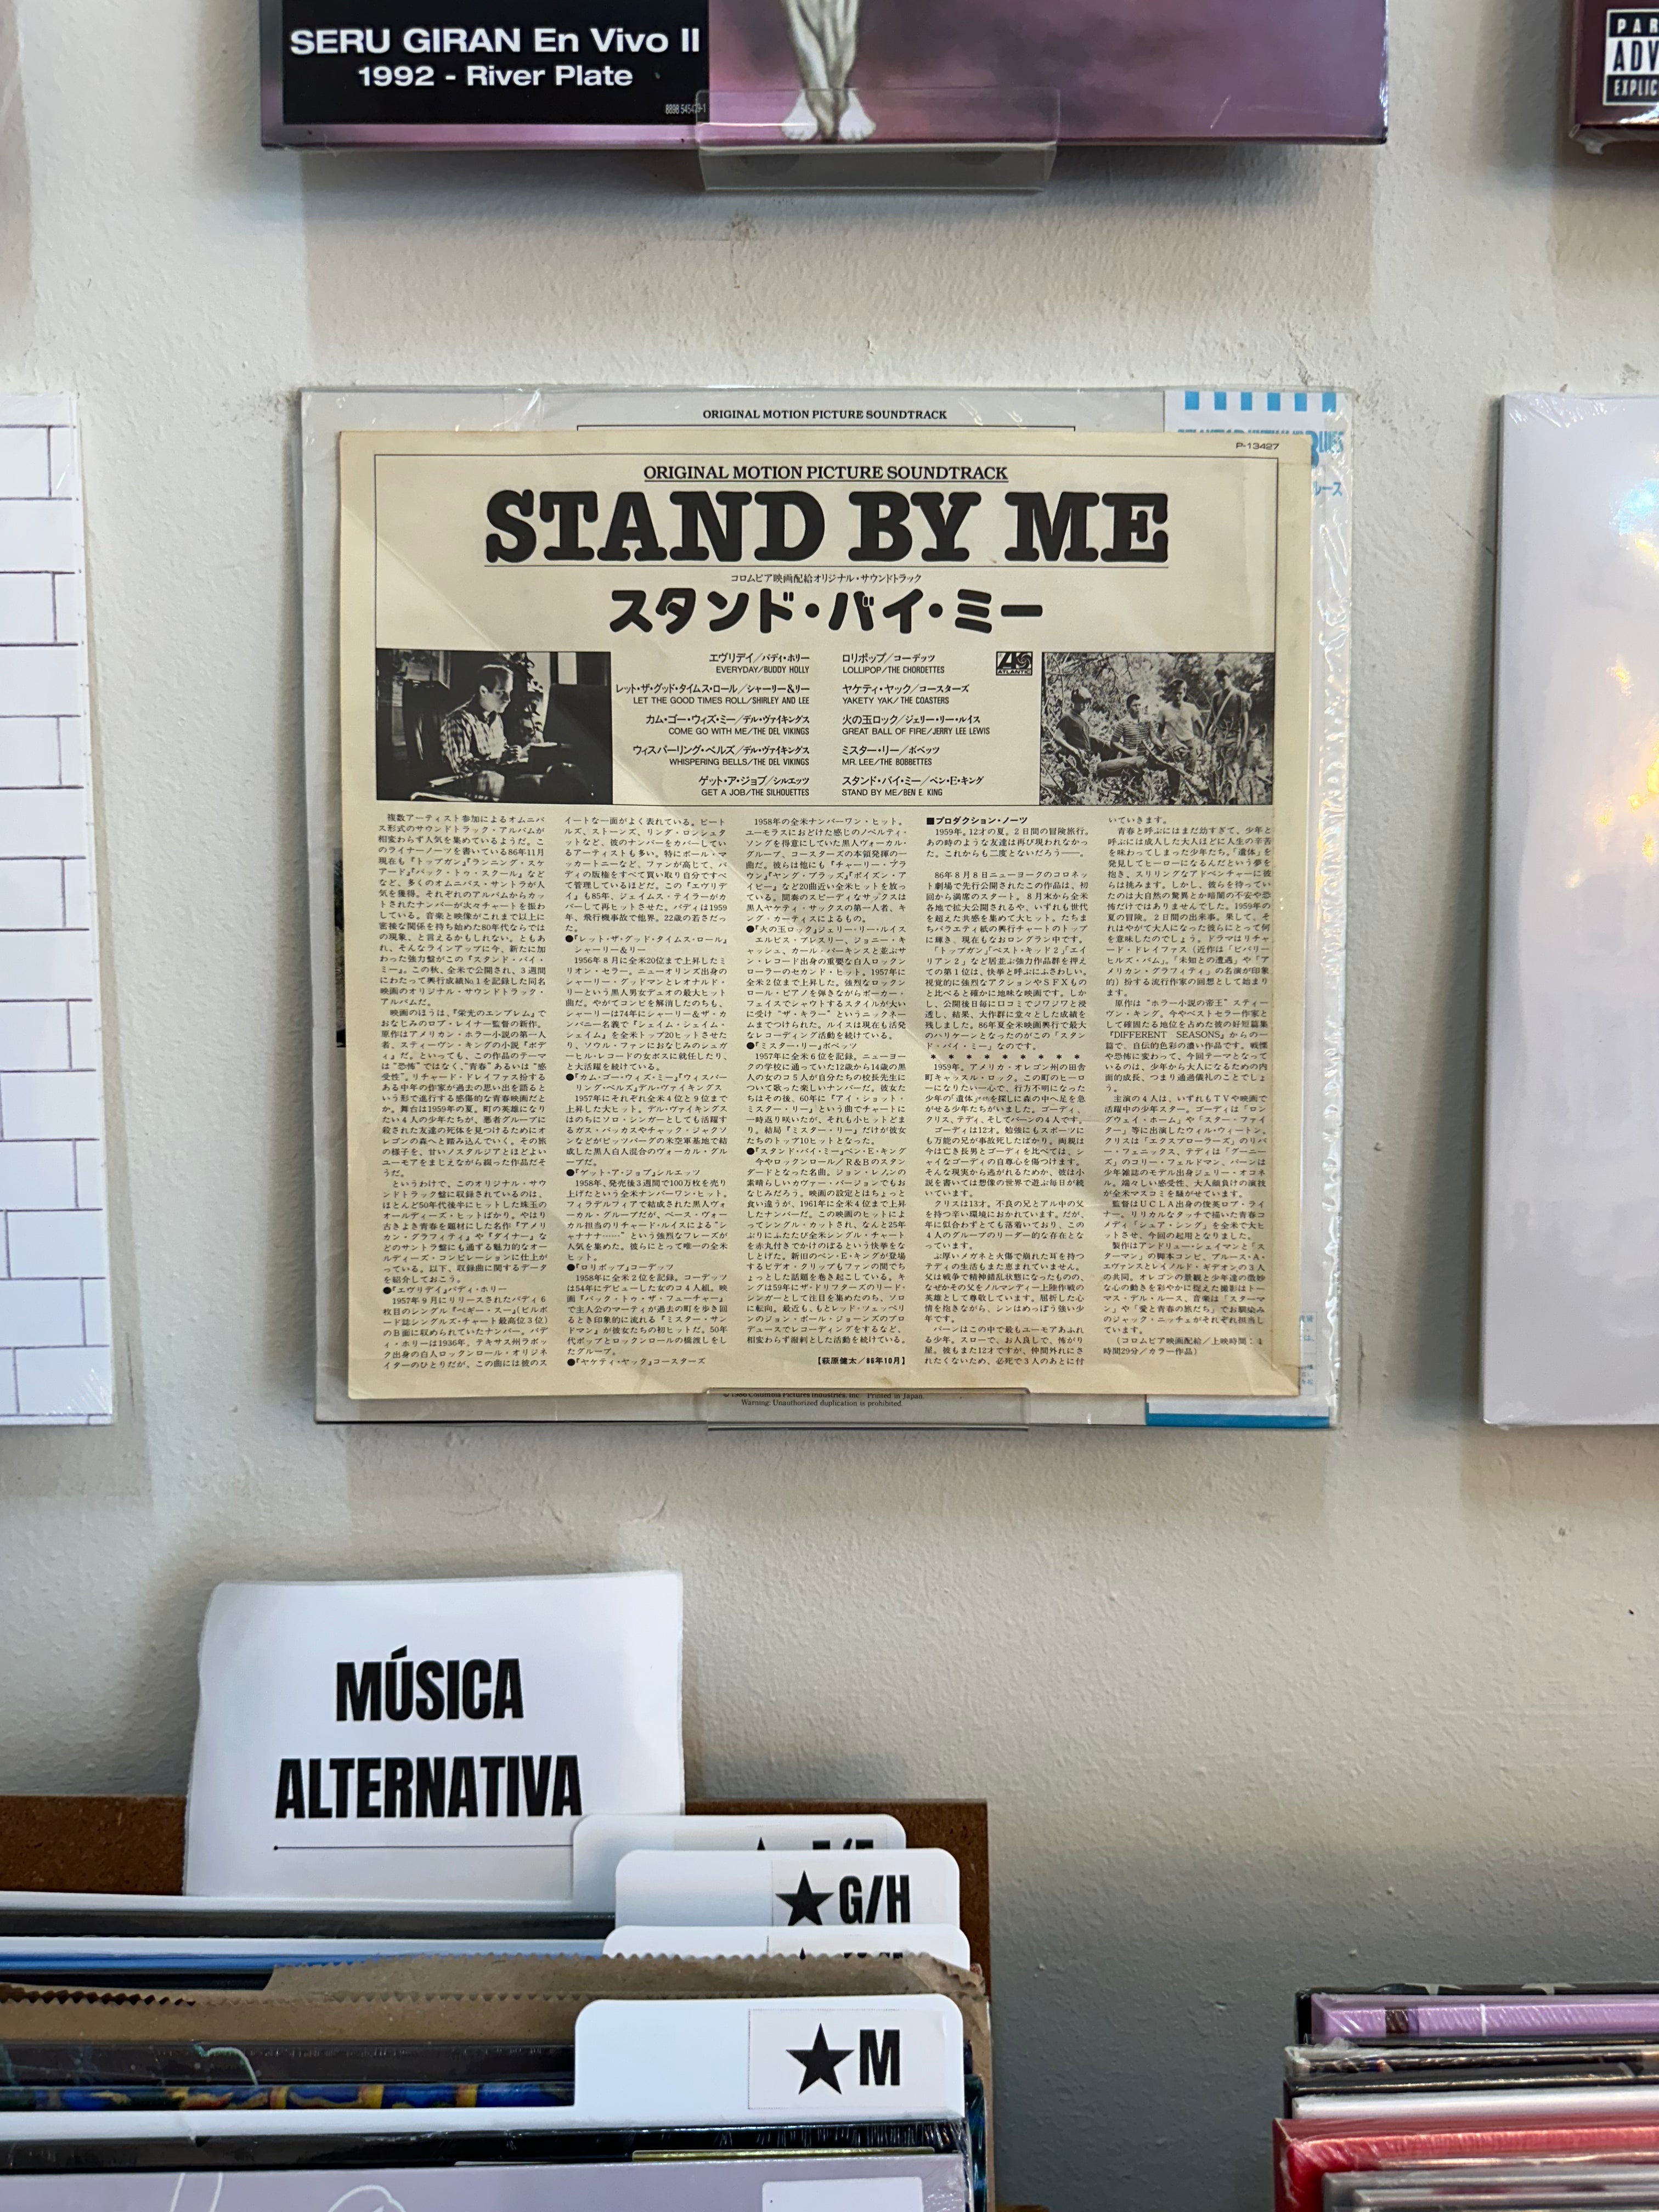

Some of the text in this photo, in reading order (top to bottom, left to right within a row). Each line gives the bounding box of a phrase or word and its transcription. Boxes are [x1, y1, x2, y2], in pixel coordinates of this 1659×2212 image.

[291, 27, 699, 55] SERU GIRAN En Vivo II
[358, 65, 435, 87] 1992
[467, 65, 546, 86] River
[555, 65, 633, 86] Plate
[703, 410, 947, 420] ORIGINAL MOTION PICTURE SOUNDTRACK
[1235, 442, 1279, 450] P-13427
[643, 466, 1009, 480] ORIGINAL MOTION PICTURE SOUNDTRACK
[486, 489, 1169, 563] STAND BY ME
[610, 588, 1043, 635] スタンド・バイ・ミー
[789, 665, 810, 674] HOLLY
[902, 665, 945, 674] CHORDETTES
[651, 696, 668, 704] THE
[670, 696, 695, 704] GOOD
[781, 696, 796, 704] AND
[798, 696, 810, 704] LEE
[900, 696, 913, 704] THE
[916, 696, 950, 704] COASTERS
[668, 727, 693, 735] COME
[768, 727, 781, 735] DEL
[783, 727, 810, 735] VIKINGS
[955, 727, 967, 735] LEE
[969, 727, 990, 735] LEWIS
[769, 758, 781, 766] DEL
[783, 758, 809, 766] VIKINGS
[895, 758, 932, 766] BOBBETTES
[766, 788, 810, 797] SILHOUETTES
[336, 1645, 524, 1722] MÚSICA
[275, 1754, 583, 1819] ALTERNATIVA
[839, 1875, 911, 1925] G/H
[859, 2029, 900, 2086] M
